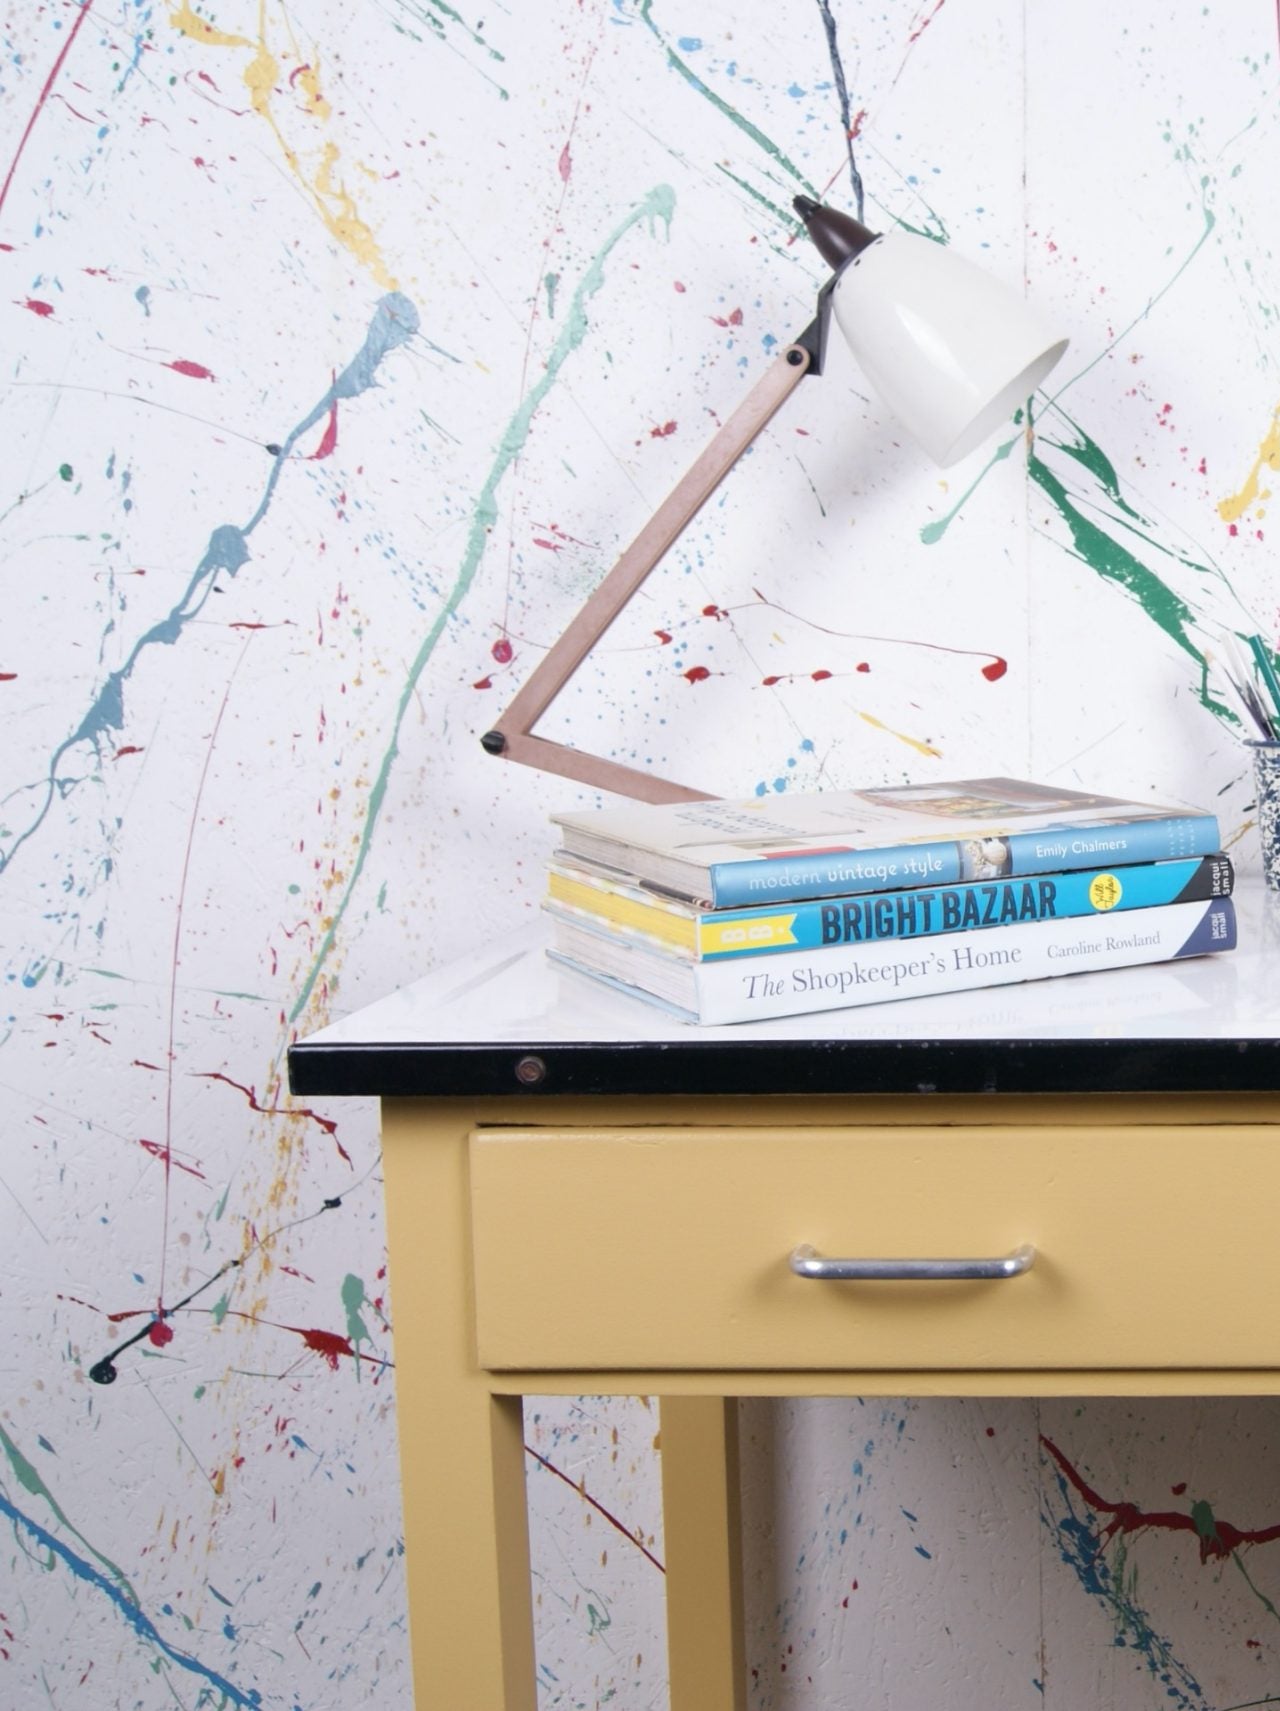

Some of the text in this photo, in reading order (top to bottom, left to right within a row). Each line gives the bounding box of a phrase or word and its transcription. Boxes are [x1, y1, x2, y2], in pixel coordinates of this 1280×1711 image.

[1036, 838, 1127, 859] Emily Chalmers
[750, 852, 943, 890] modern vintage style
[1210, 862, 1221, 896] jacqui
[1220, 860, 1230, 895] small
[821, 881, 1057, 944] BRIGHT BAZAAR
[1210, 913, 1220, 940] jacqui
[1218, 912, 1227, 939] small
[1047, 931, 1161, 959] Caroline Rowland
[742, 973, 784, 999] The
[952, 943, 1022, 970] Home
